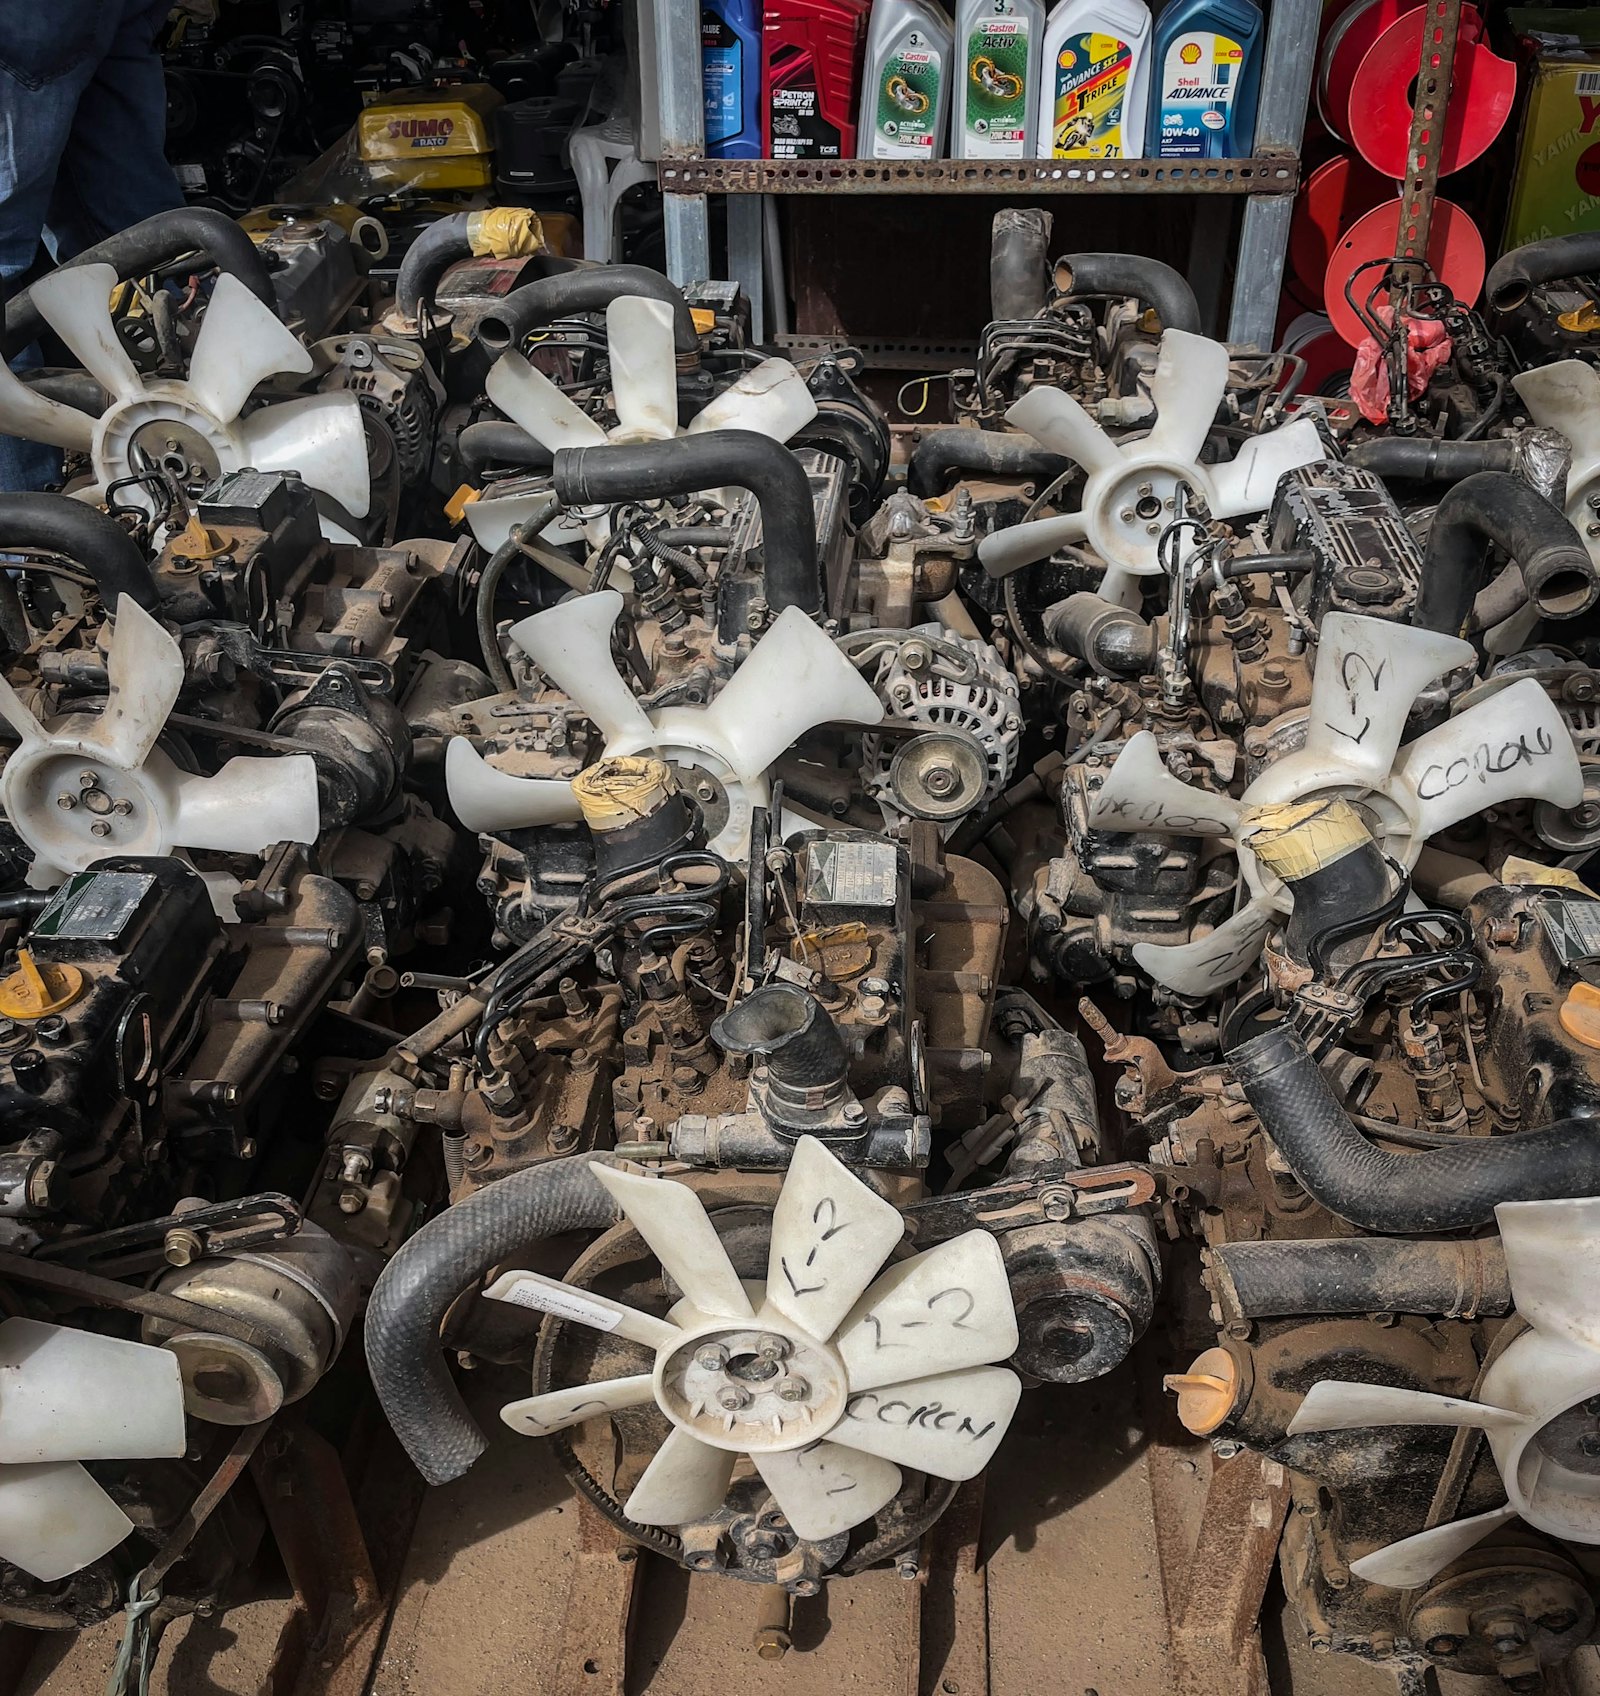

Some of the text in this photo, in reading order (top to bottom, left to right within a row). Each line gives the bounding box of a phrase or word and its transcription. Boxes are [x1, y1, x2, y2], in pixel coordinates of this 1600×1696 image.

[988, 23, 1016, 34] Castrol
[982, 35, 1016, 48] Activ
[904, 52, 929, 62] Castrol
[897, 62, 928, 74] Activ
[1060, 61, 1101, 97] ADVANCE
[1178, 78, 1200, 87] Shell
[782, 90, 815, 100] PETRON
[1087, 77, 1118, 104] TRIPLE
[1166, 87, 1230, 99] ADVANCE
[387, 117, 454, 139] SUMO
[1162, 127, 1200, 137] 10W-40
[420, 138, 444, 146] RATO
[1105, 144, 1120, 158] 2T
